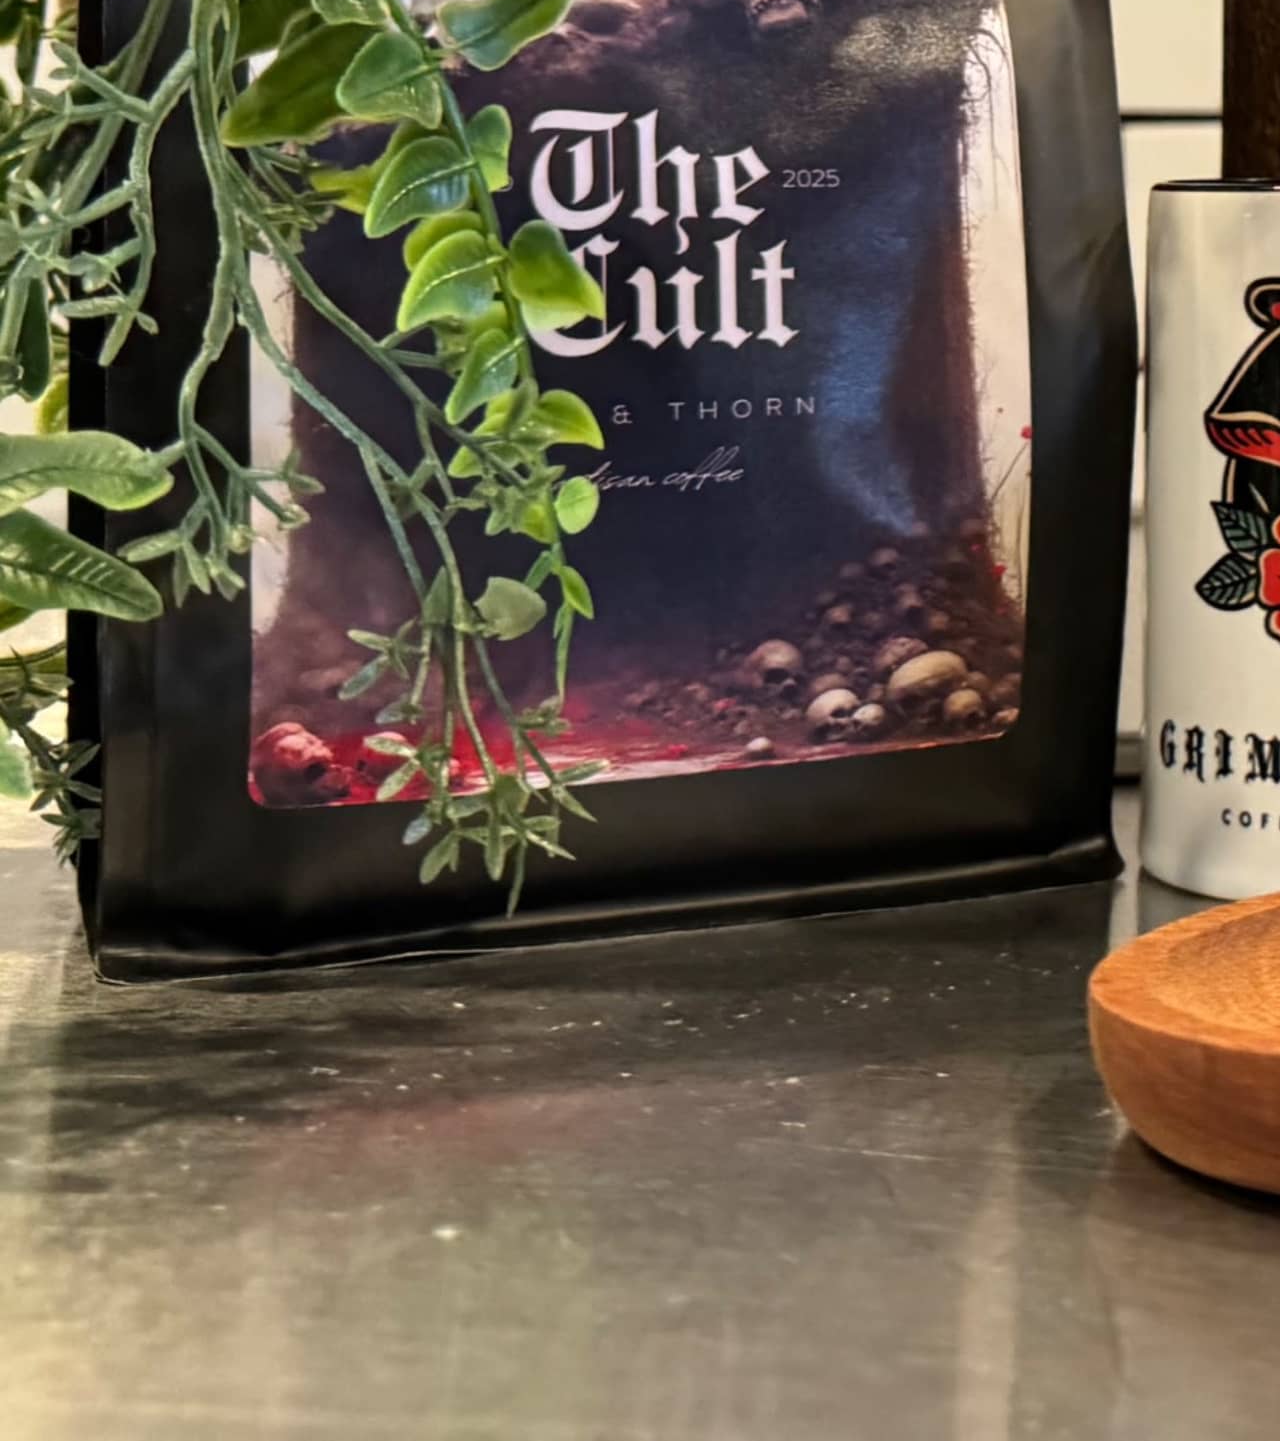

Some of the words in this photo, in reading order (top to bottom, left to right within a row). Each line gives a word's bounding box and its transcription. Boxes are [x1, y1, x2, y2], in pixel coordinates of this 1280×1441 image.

[530, 108, 771, 254] The
[782, 169, 841, 188] 2025
[612, 404, 632, 425] &
[668, 397, 816, 420] THORN
[662, 446, 745, 491] coffee
